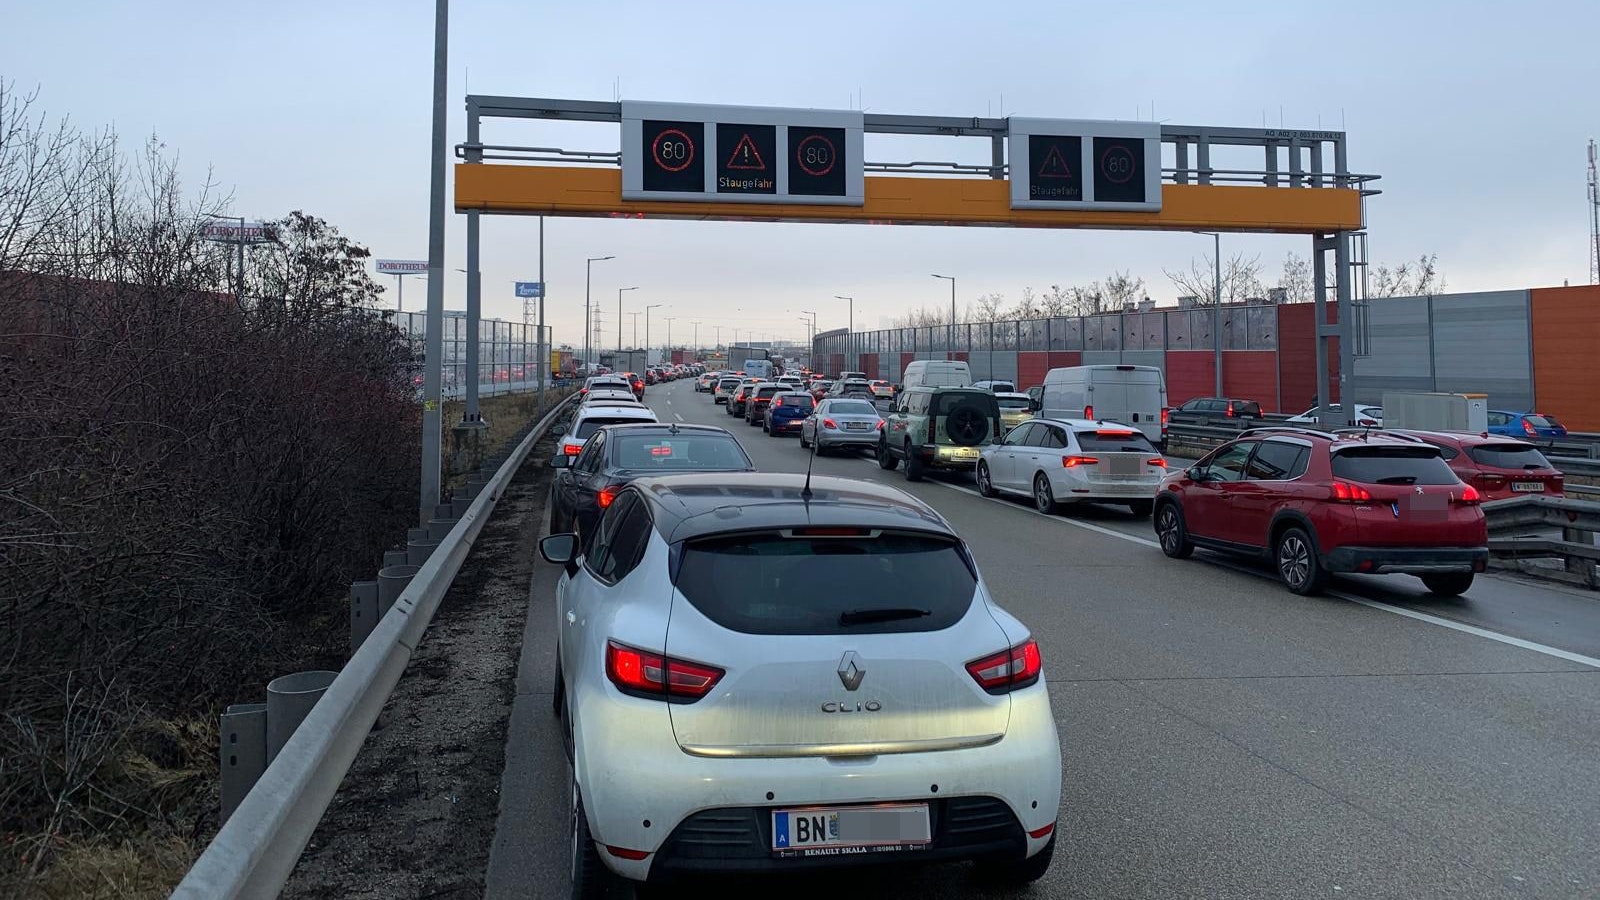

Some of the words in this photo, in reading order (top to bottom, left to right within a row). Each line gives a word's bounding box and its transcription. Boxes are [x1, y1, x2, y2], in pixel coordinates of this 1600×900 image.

[662, 141, 685, 159] 80
[806, 147, 828, 164] 80
[1109, 157, 1128, 172] 80
[719, 177, 773, 189] Staugefahr
[1031, 185, 1078, 196] Staugefahr
[821, 700, 882, 713] CLIO
[796, 816, 826, 842] BN
[778, 834, 786, 842] A
[841, 846, 867, 854] SKALA
